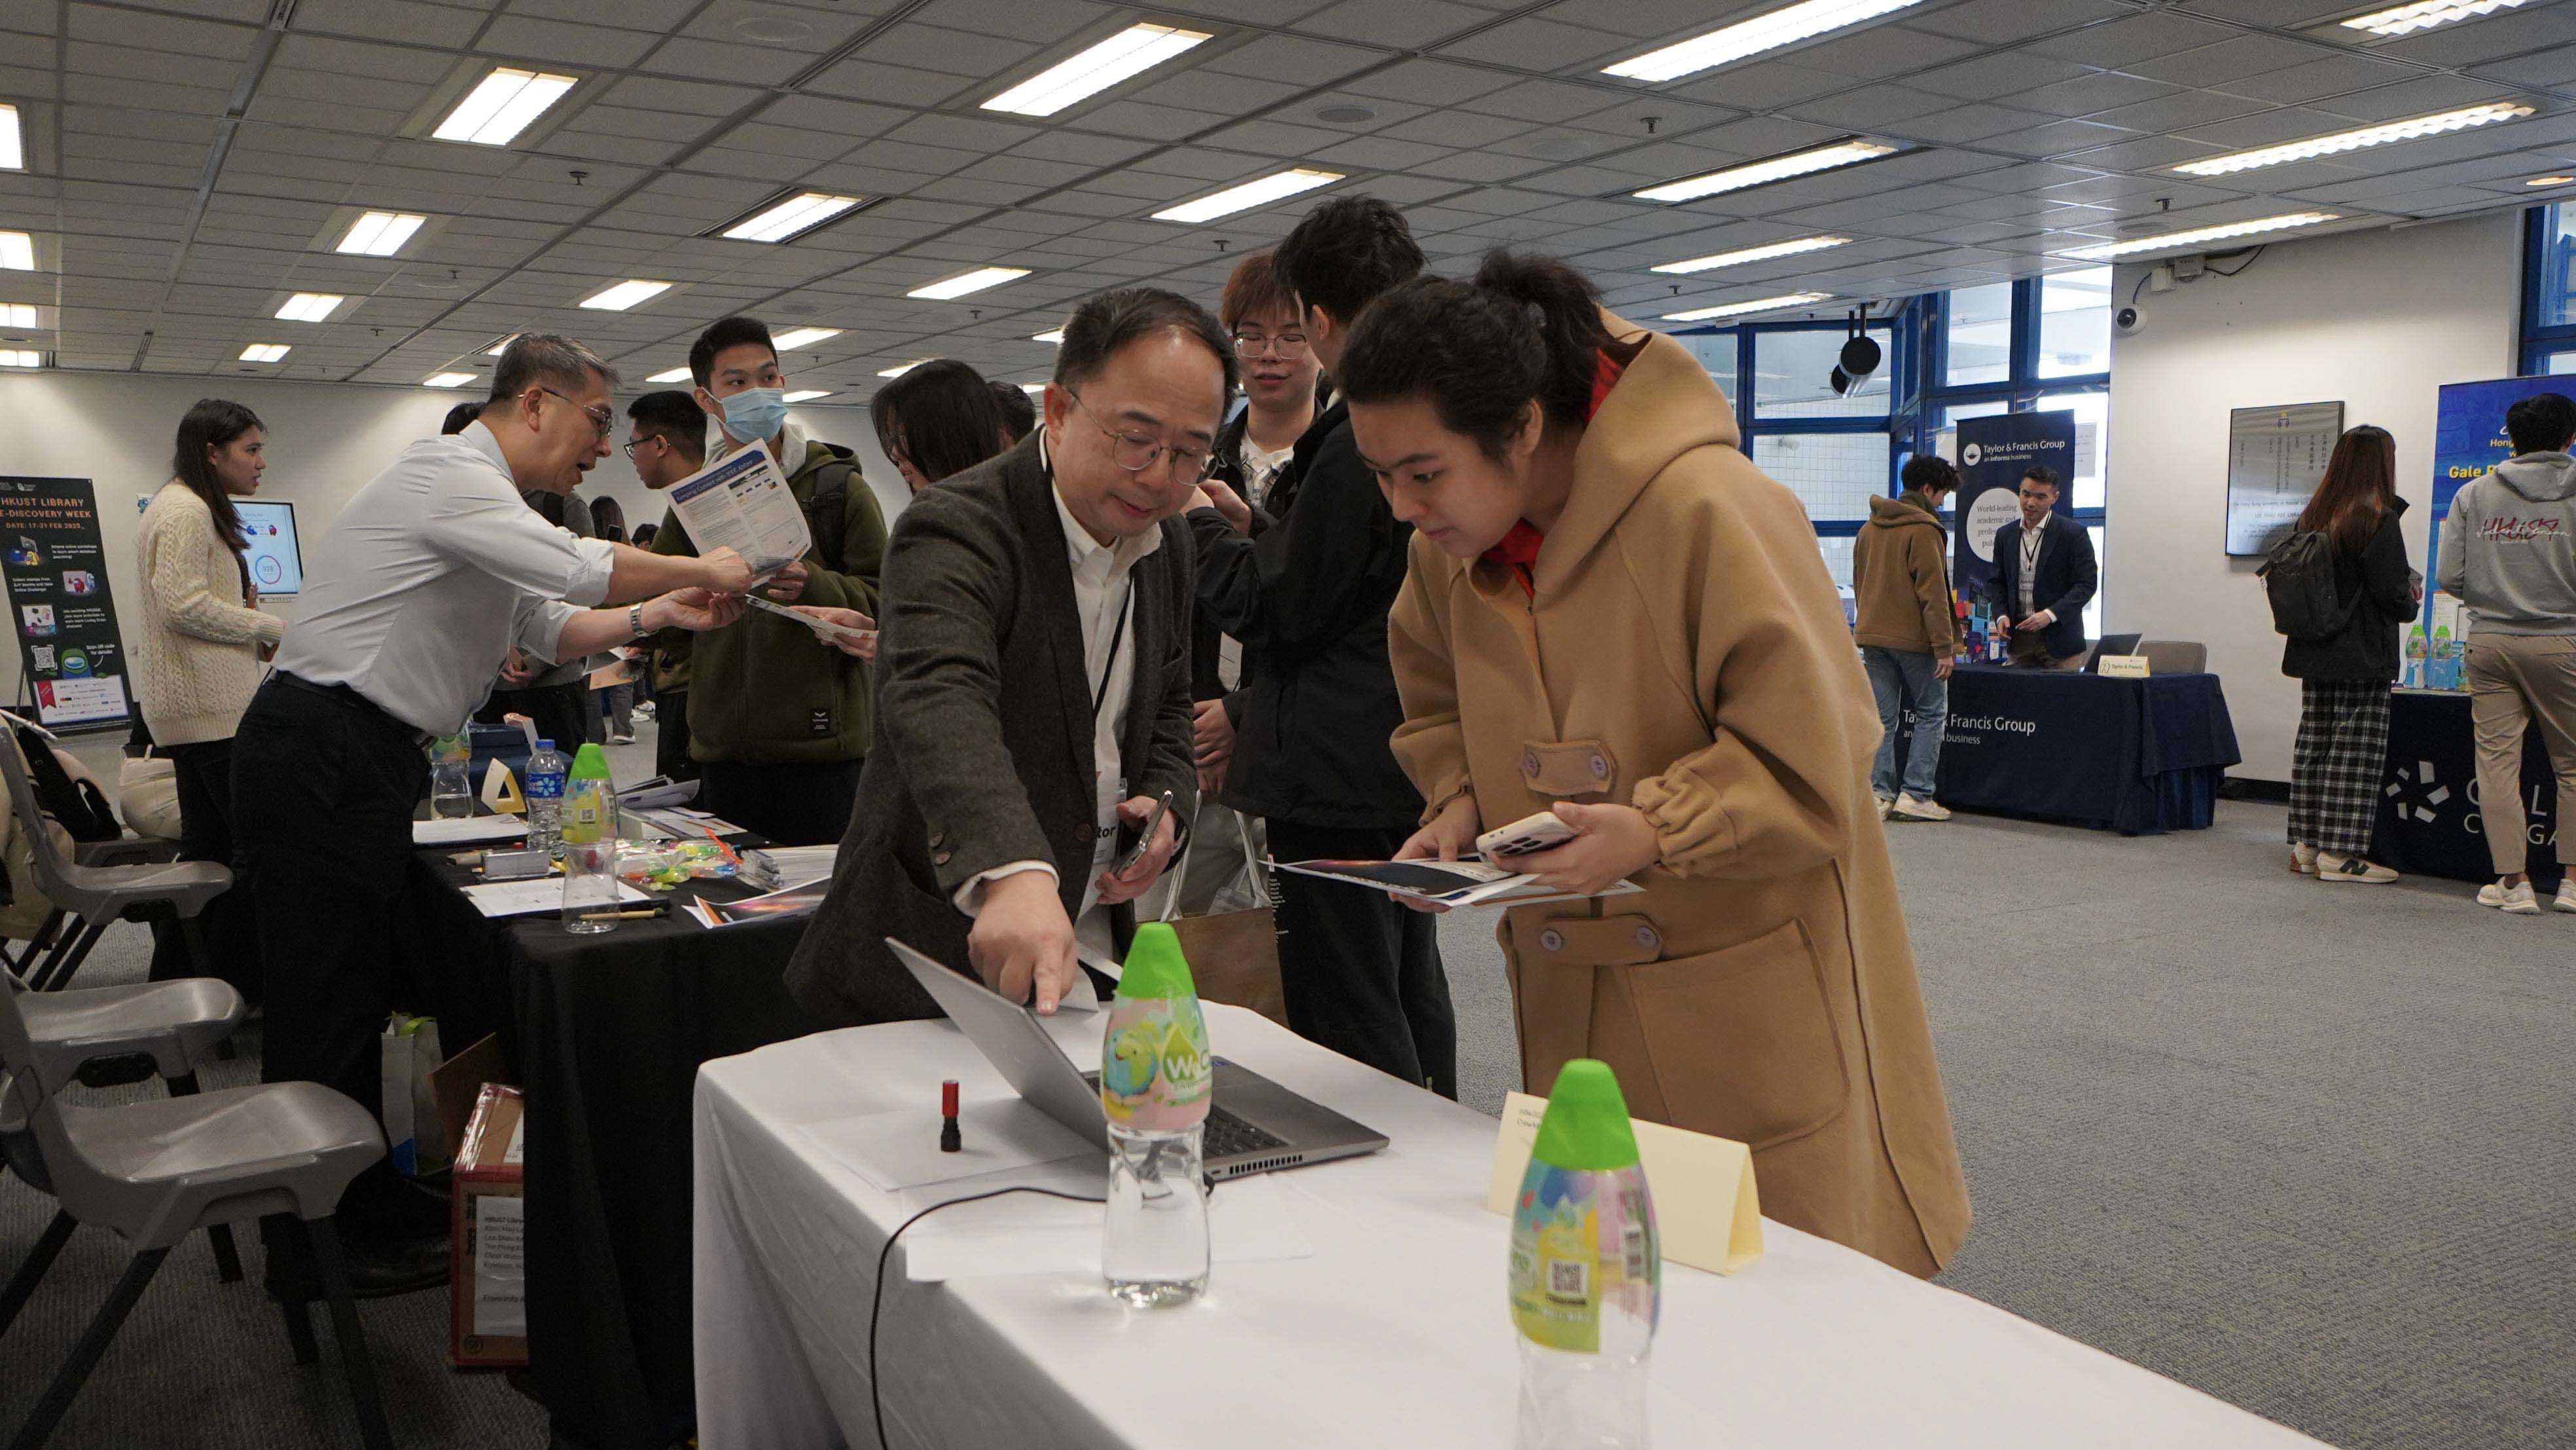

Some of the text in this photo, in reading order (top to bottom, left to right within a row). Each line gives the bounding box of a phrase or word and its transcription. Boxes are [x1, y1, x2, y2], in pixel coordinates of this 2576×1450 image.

[1984, 444, 2004, 455] Taylor
[2012, 442, 2038, 451] Francis
[2039, 440, 2066, 450] Group
[2490, 439, 2514, 448] Hong
[2449, 465, 2482, 478] Gale
[1, 497, 84, 506] HKUST LIBRARY
[1977, 504, 2017, 513] World-leading
[1978, 528, 1997, 537] profes
[1950, 714, 2036, 737] Francis Group
[1903, 730, 1980, 745] an business
